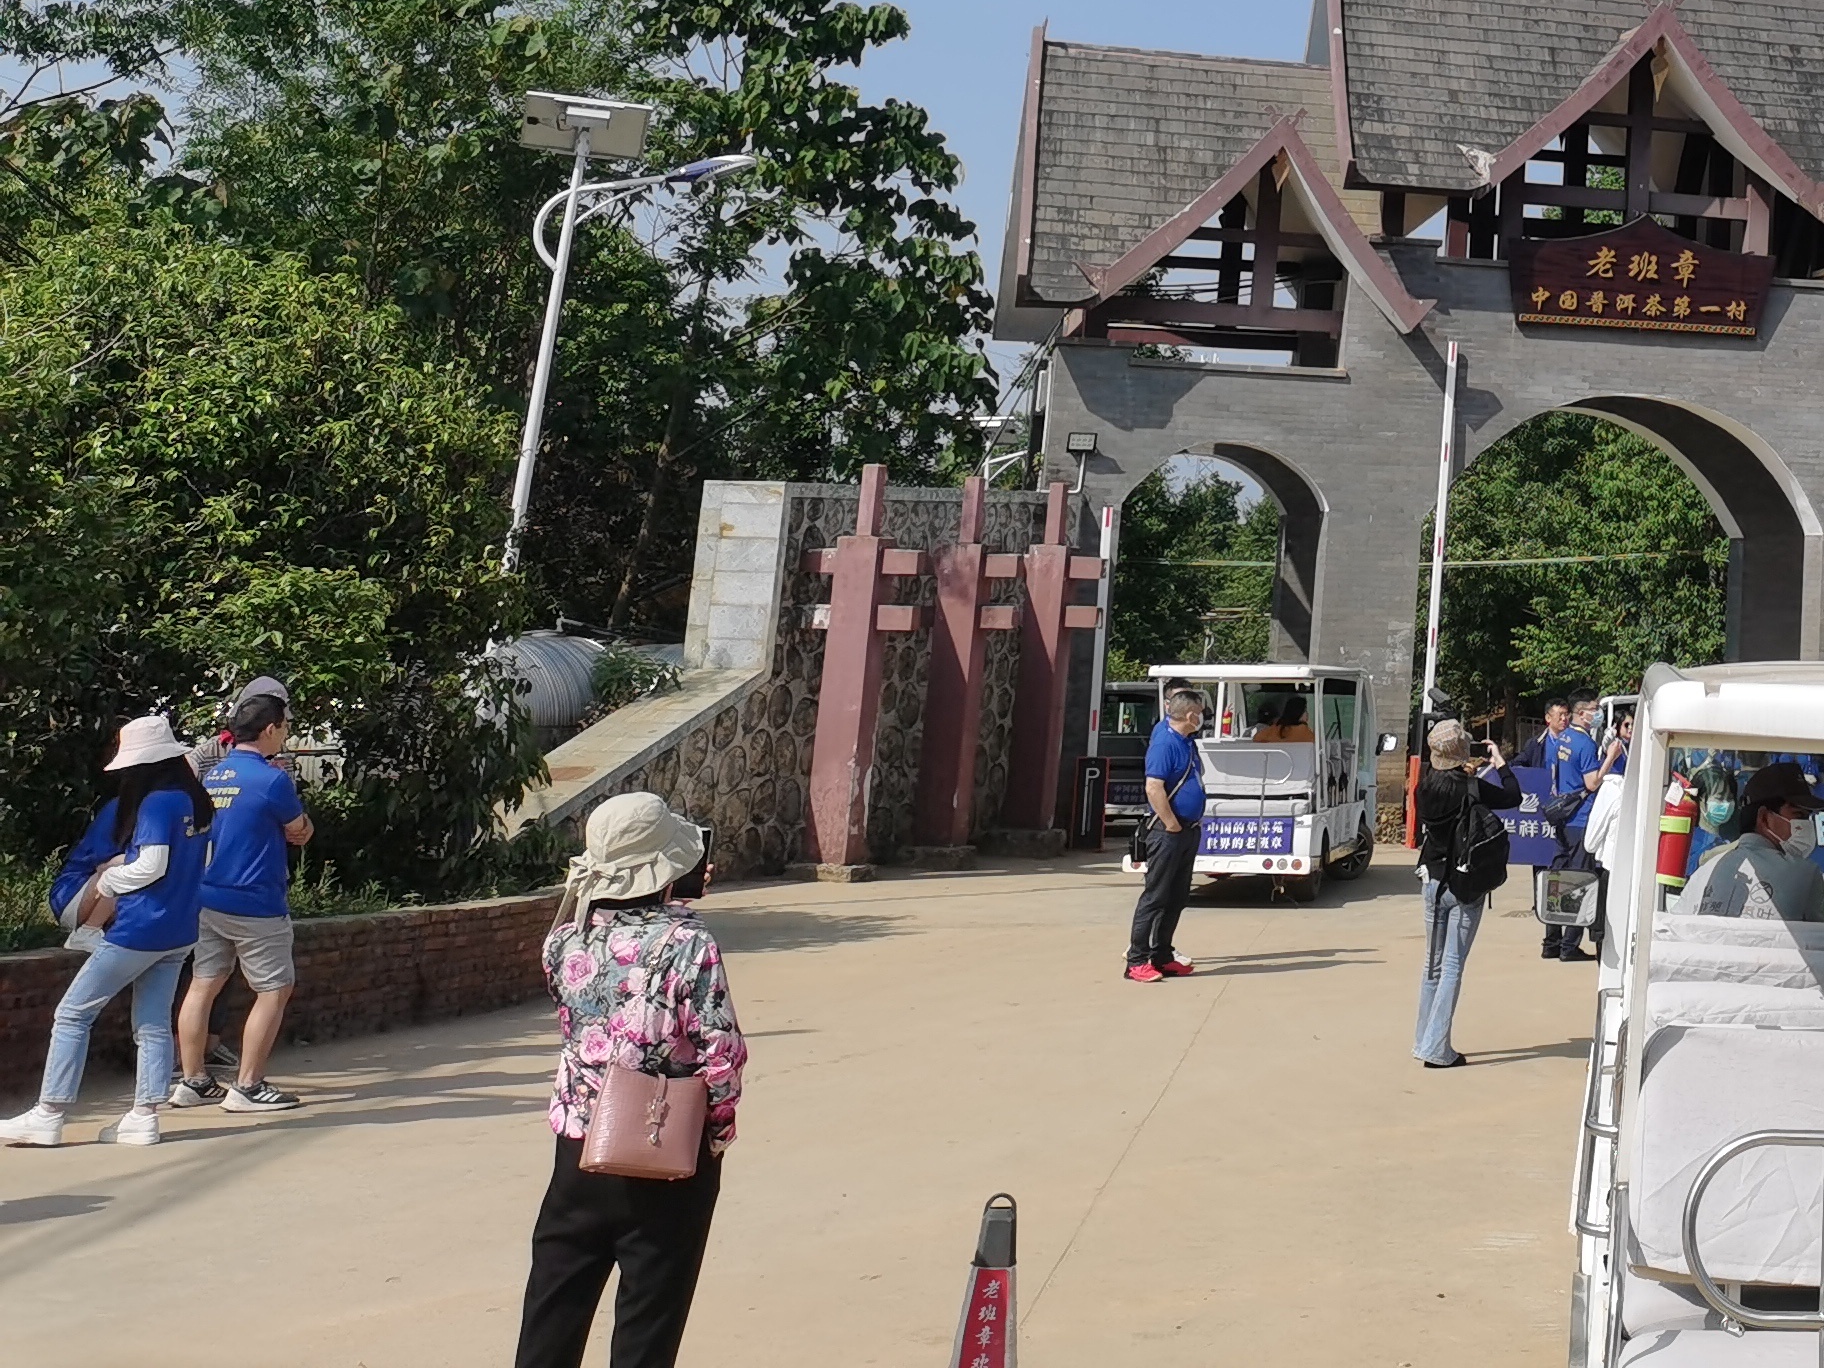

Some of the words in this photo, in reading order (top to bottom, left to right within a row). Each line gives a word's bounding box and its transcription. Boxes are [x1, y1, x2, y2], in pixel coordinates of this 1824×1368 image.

[1586, 245, 1700, 288] 老班章
[1531, 286, 1747, 322] 中国普洱茶第一村
